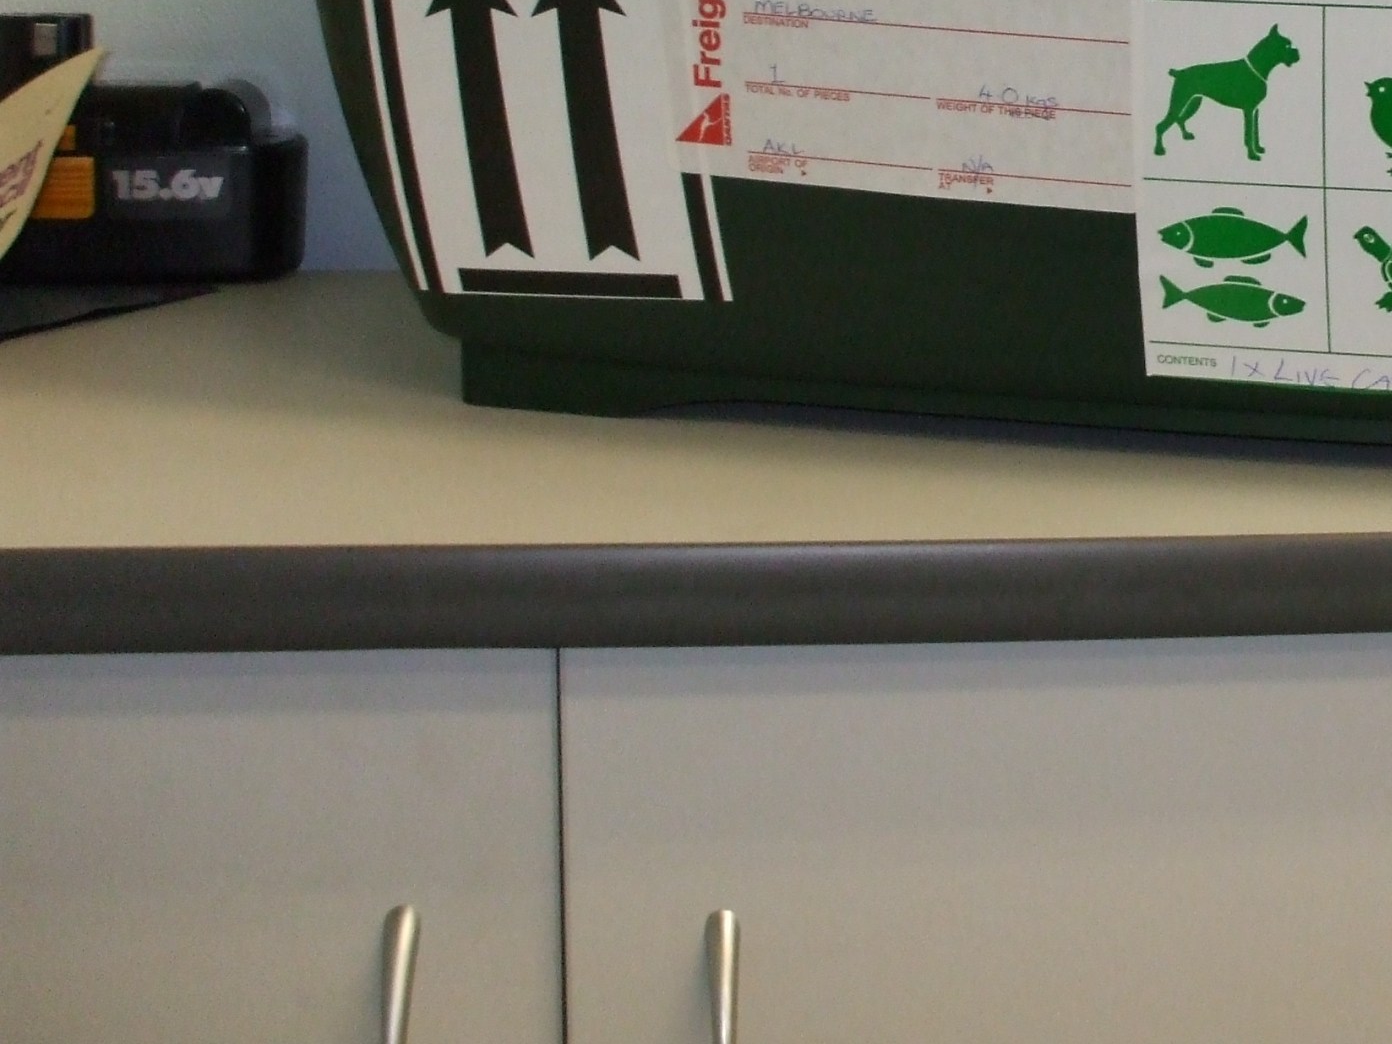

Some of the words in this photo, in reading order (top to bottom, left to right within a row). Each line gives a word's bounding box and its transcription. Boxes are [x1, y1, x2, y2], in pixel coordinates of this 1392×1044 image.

[755, 0, 877, 22] MELBOURNE
[743, 15, 810, 29] DESTINATION
[745, 84, 774, 95] TOTAL
[796, 89, 809, 97] OF
[815, 90, 850, 101] PIECES
[937, 101, 976, 113] WEIGHT
[981, 105, 994, 114] OF
[763, 139, 805, 155] AKL
[112, 169, 224, 201] 15.6v
[939, 173, 994, 185] TRANSFER
[1157, 355, 1217, 367] CONTENTS
[1273, 358, 1339, 386] LIVE
